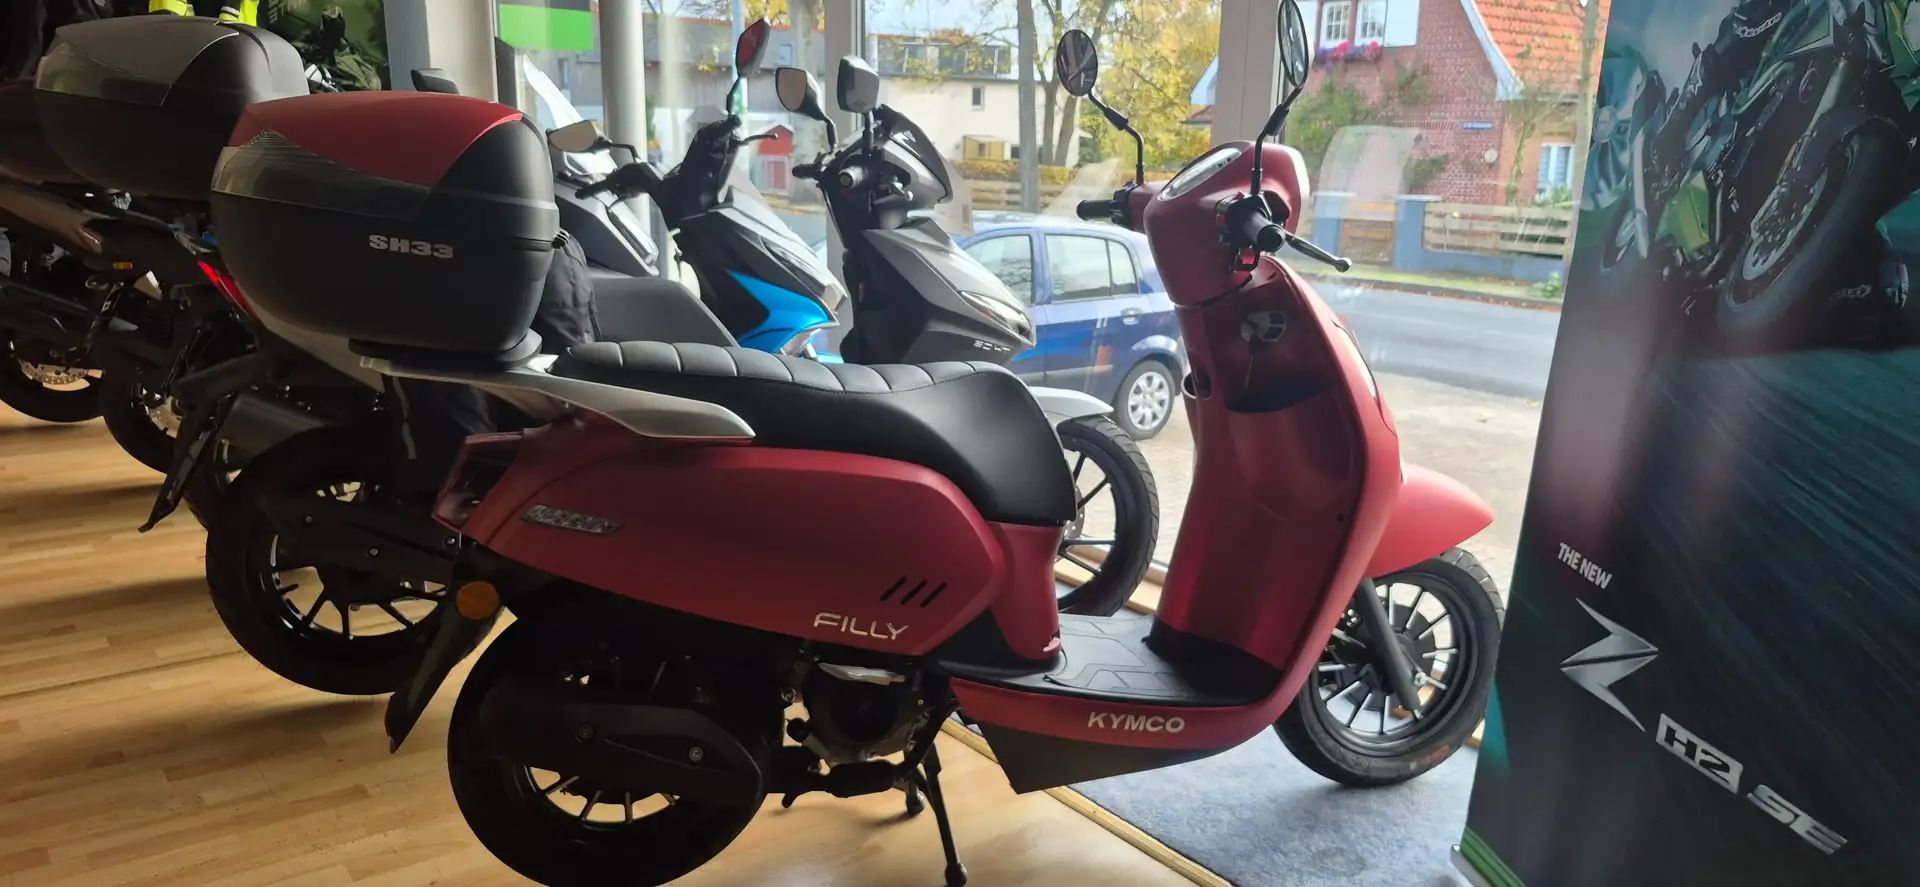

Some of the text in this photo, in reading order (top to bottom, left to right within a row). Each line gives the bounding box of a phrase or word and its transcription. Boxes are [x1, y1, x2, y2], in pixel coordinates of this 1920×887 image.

[368, 234, 454, 259] SH33
[1557, 541, 1613, 590] THE NEW
[813, 611, 909, 640] FILLY
[1087, 711, 1186, 734] KYMCO
[1659, 718, 1848, 855] H2 SE
